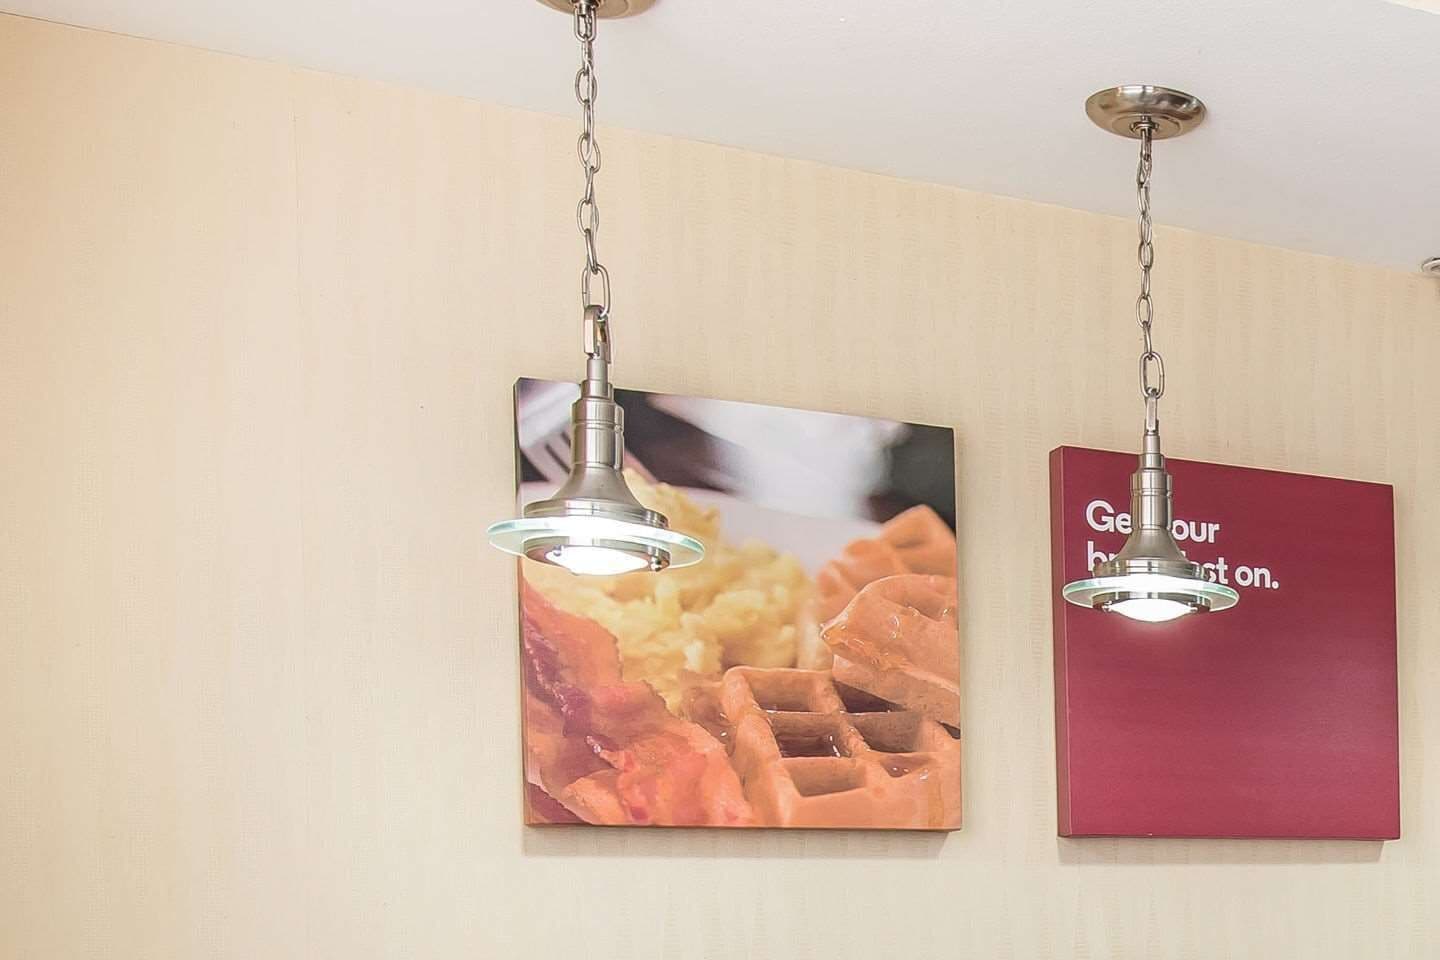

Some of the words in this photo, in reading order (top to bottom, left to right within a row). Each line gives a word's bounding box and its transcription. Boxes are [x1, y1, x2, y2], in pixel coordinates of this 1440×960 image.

[1086, 499, 1133, 535] Ge
[1171, 518, 1220, 544] our
[1234, 564, 1280, 590] on.
